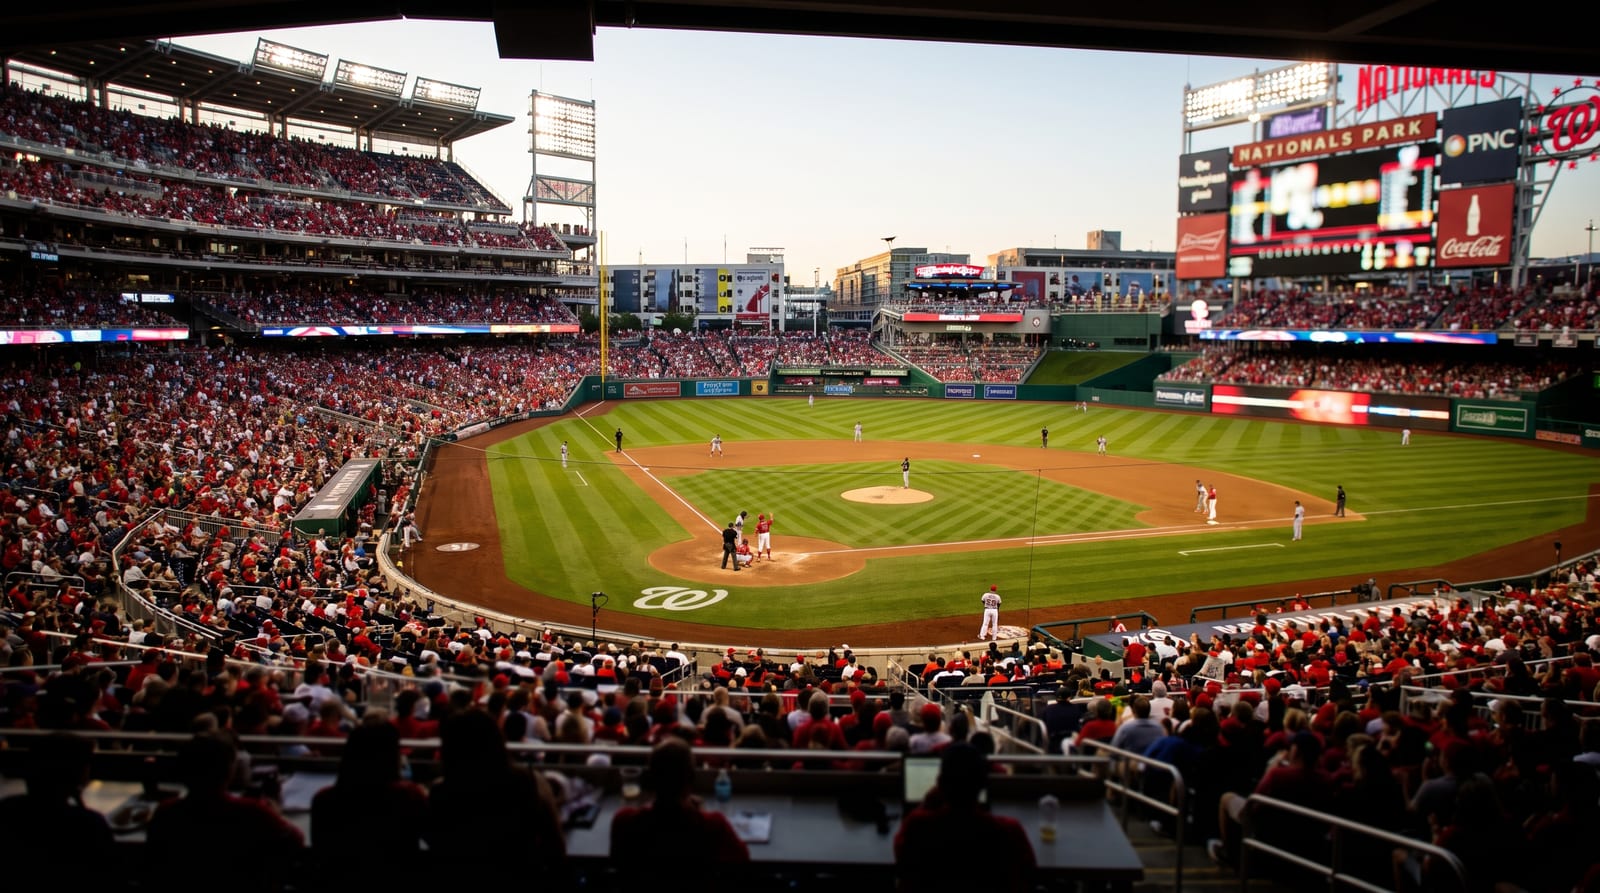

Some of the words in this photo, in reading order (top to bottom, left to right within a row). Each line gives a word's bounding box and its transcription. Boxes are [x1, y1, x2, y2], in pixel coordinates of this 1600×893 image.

[1239, 132, 1353, 162] NATIONALS
[1362, 119, 1422, 143] PARK
[1468, 128, 1517, 153] PNC
[633, 586, 729, 611] W
